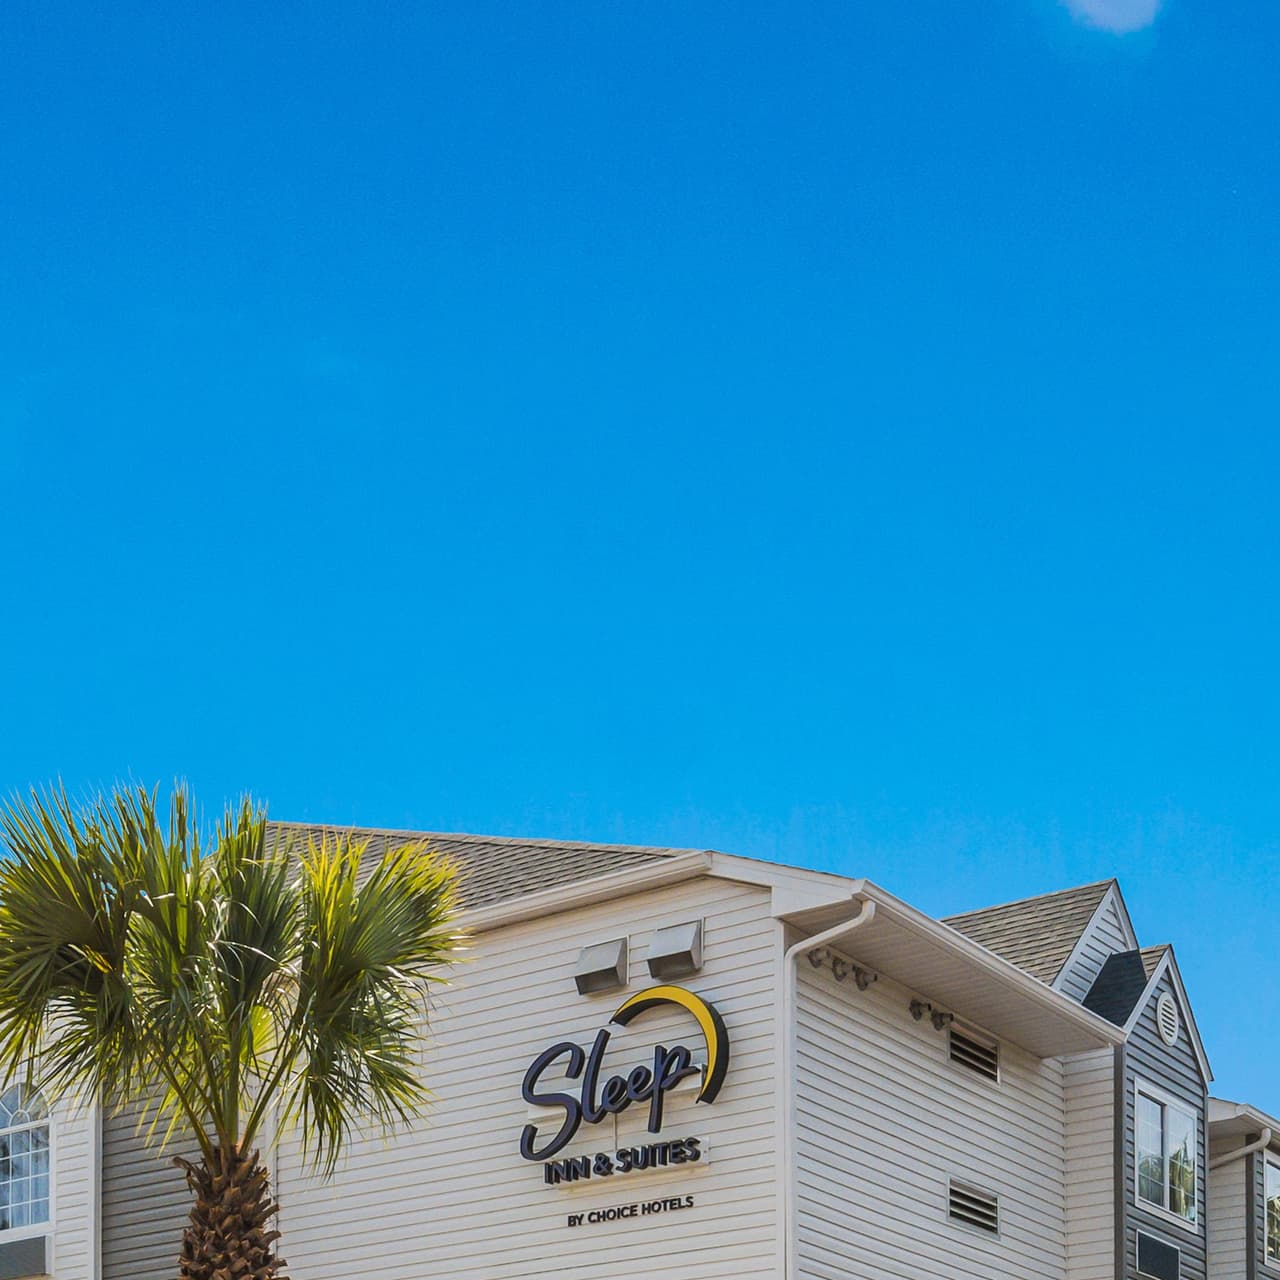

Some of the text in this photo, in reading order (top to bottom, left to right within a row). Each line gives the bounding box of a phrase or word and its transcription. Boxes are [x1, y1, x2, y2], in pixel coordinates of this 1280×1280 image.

[520, 1029, 701, 1161] Sleep
[545, 1137, 701, 1184] INN & SUITES
[568, 1196, 694, 1227] BY CHOICE HOTELS
